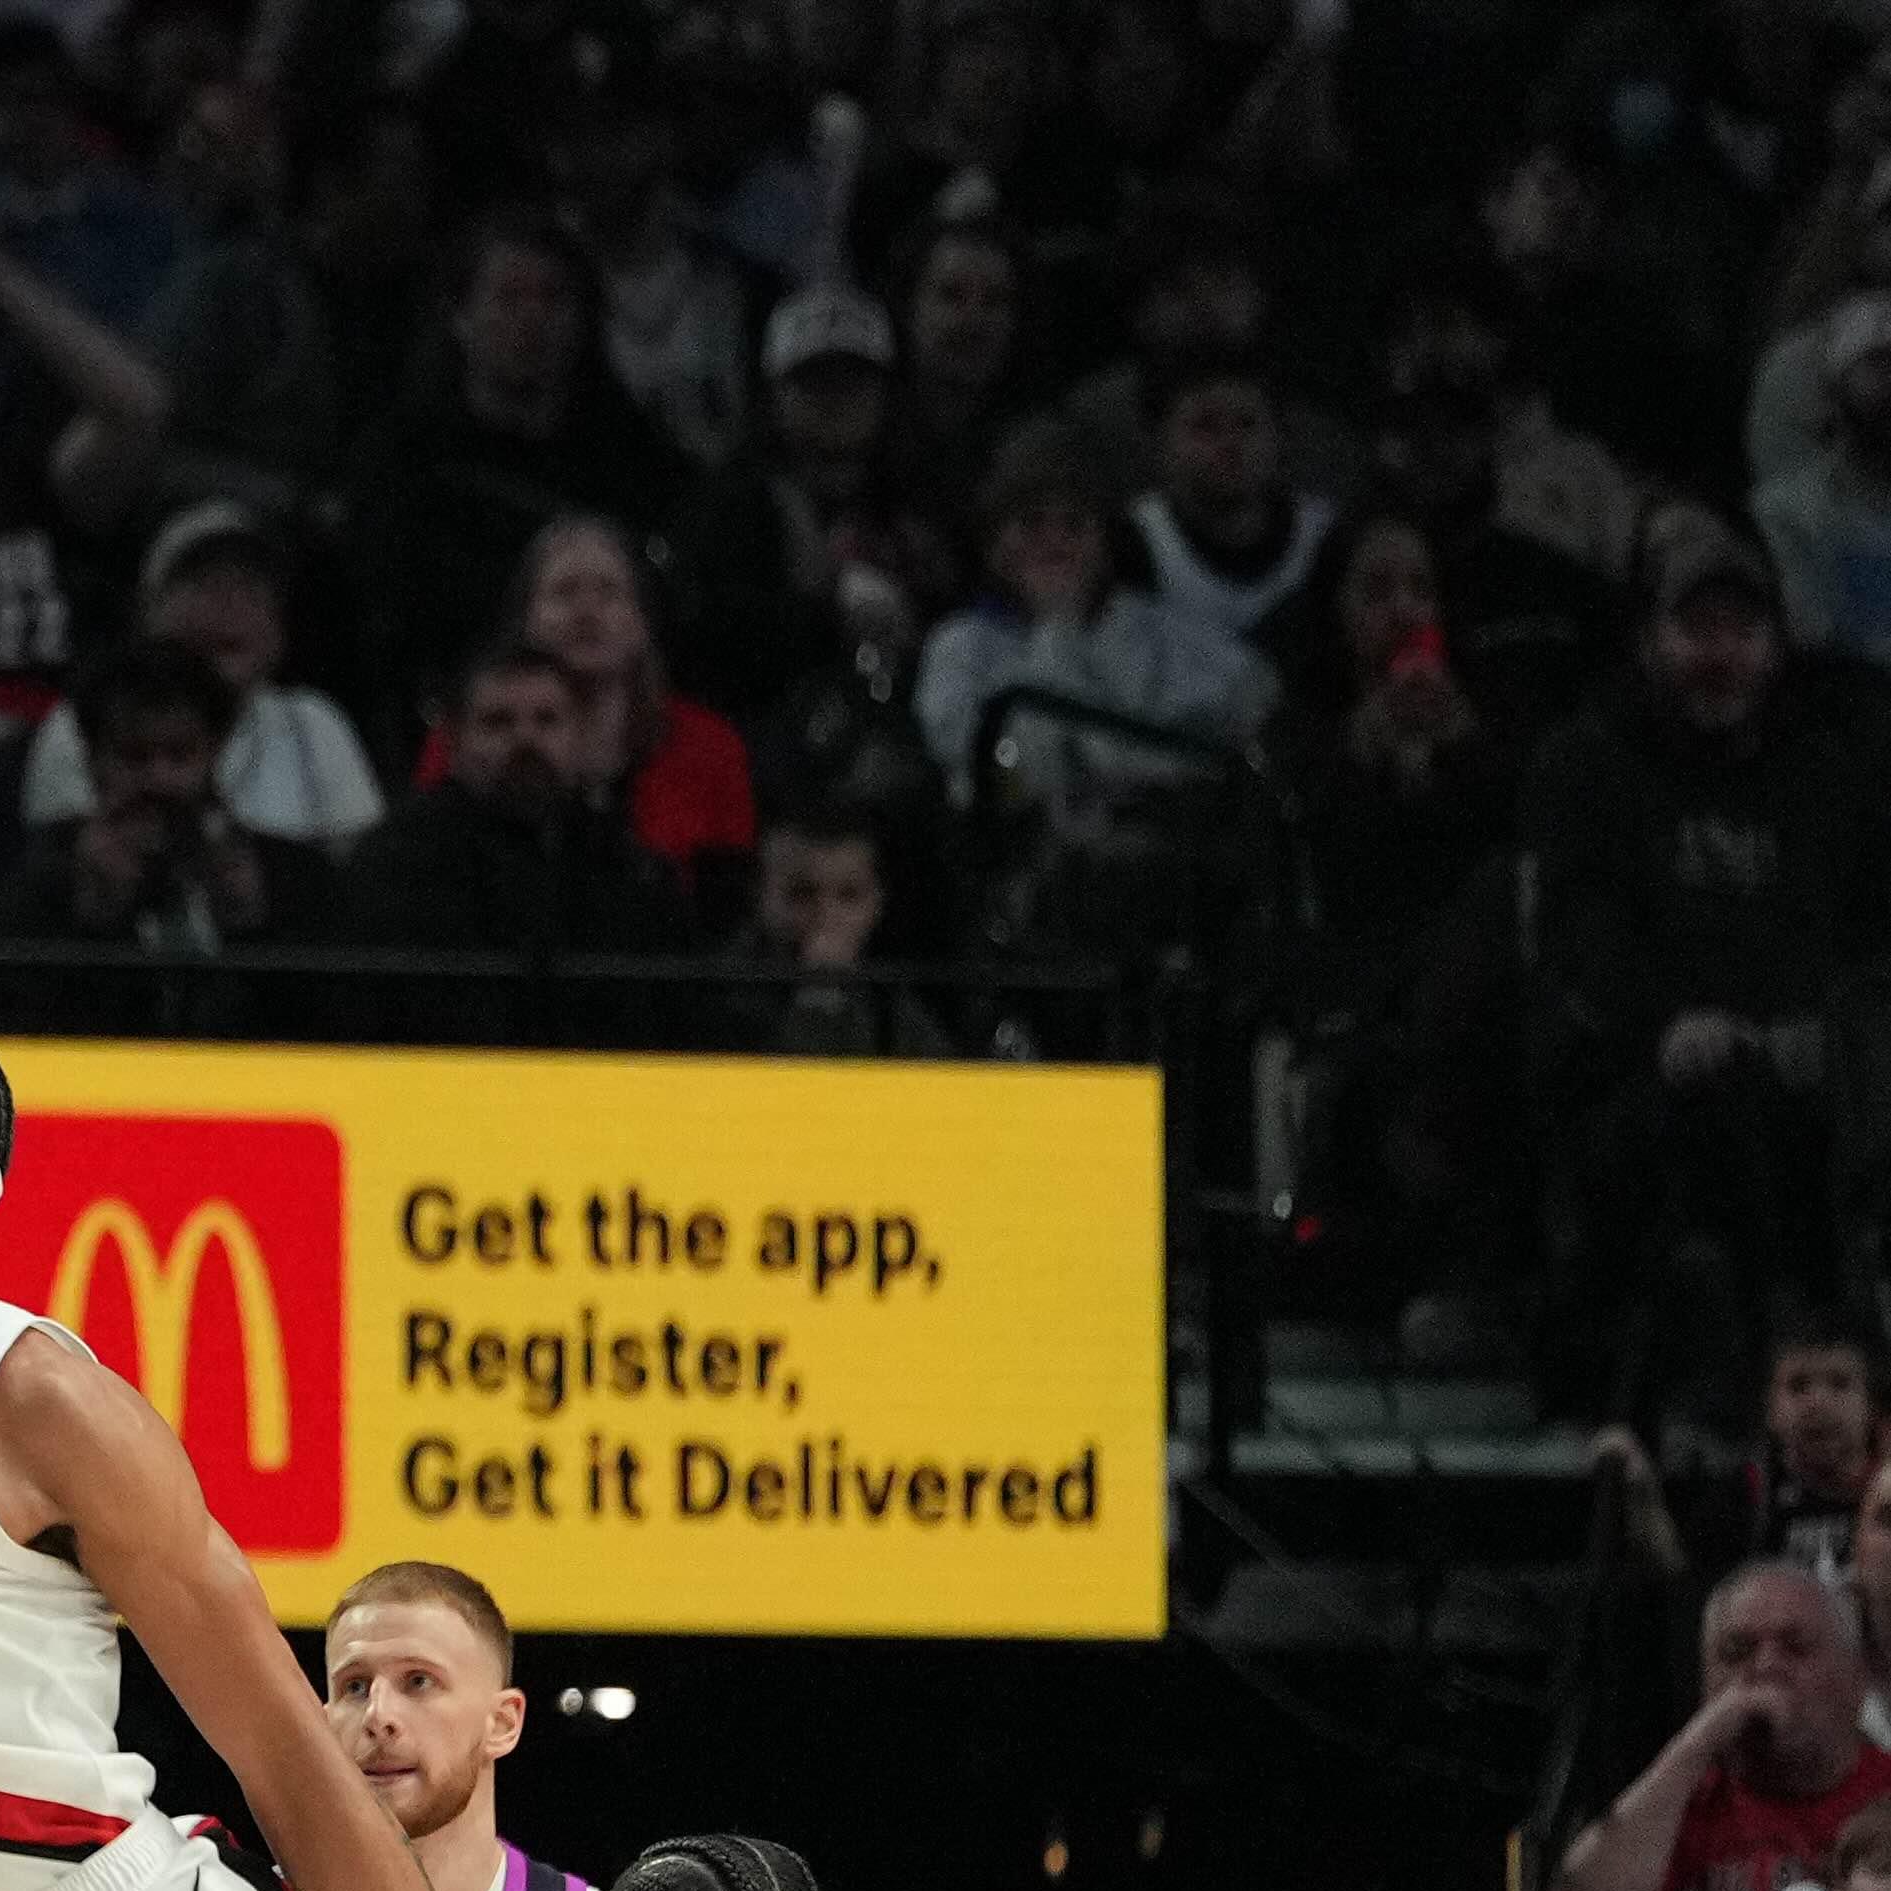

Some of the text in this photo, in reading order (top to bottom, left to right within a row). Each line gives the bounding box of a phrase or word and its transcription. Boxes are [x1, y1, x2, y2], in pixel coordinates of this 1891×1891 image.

[401, 1185, 942, 1296] Get the app,
[402, 1306, 800, 1415] Register,
[401, 1431, 1100, 1526] Get it Delivered
